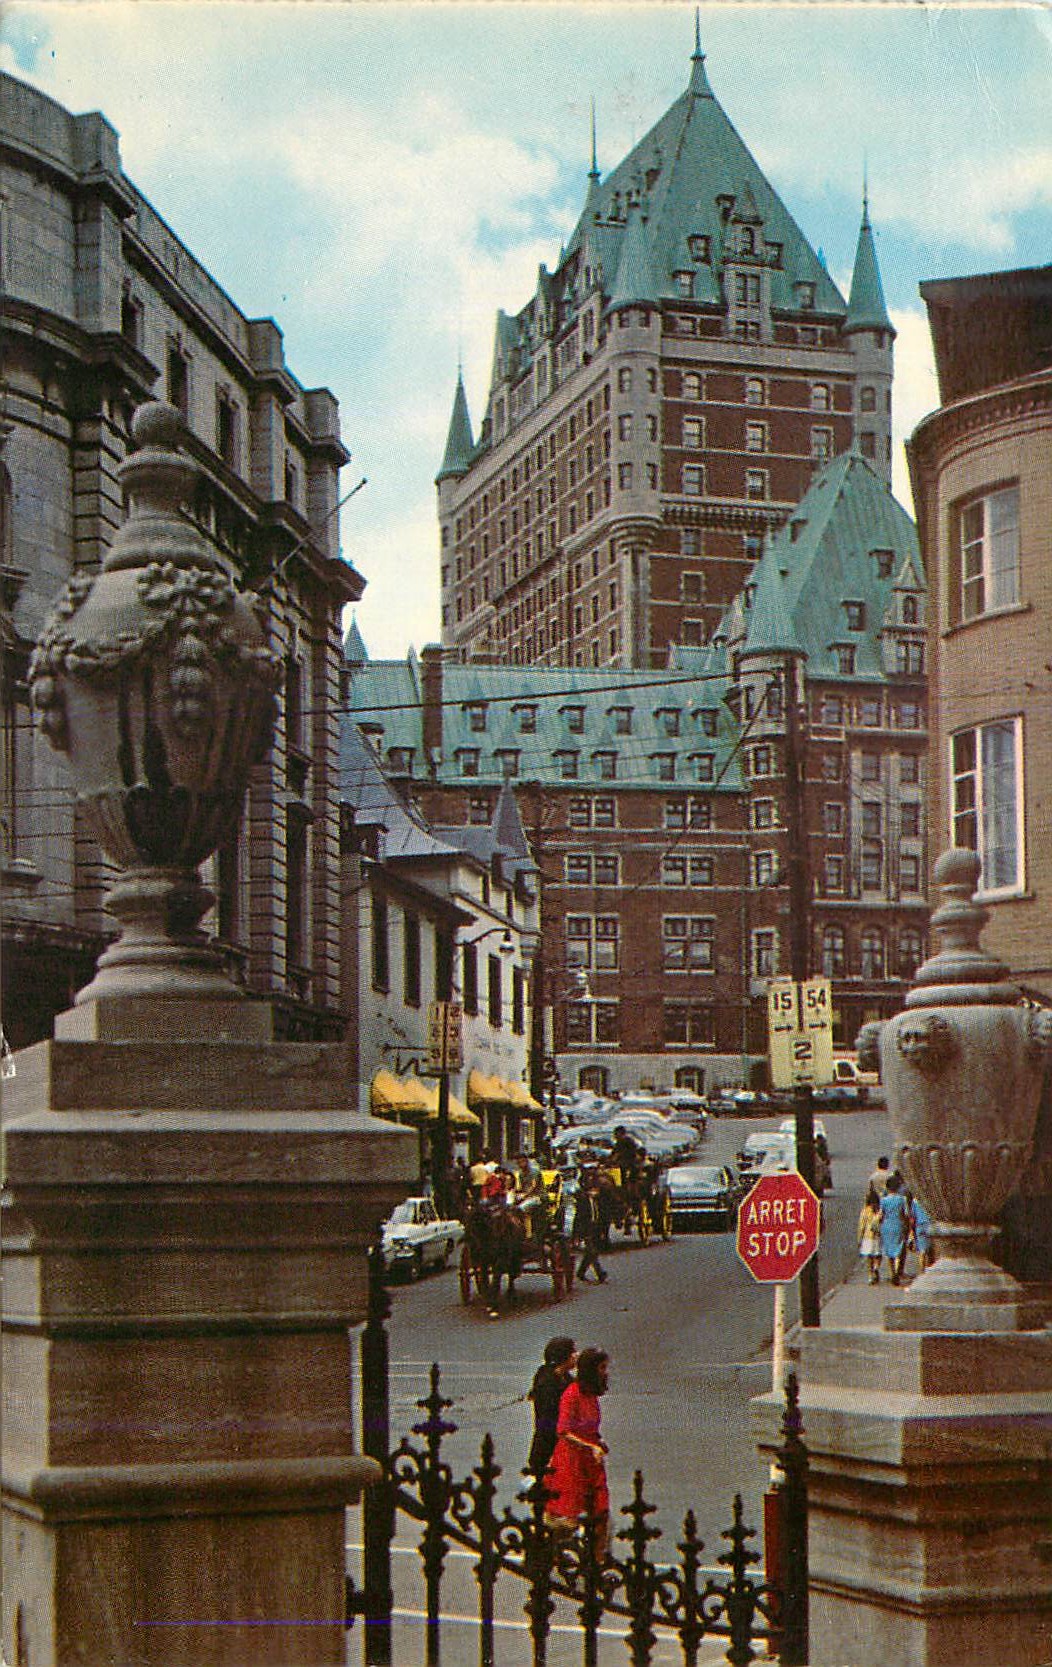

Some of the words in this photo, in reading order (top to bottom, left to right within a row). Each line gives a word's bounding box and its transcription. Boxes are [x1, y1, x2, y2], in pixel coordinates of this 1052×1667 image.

[773, 991, 793, 1010] 15
[807, 988, 827, 1008] 54
[793, 1040, 812, 1060] 2
[746, 1198, 807, 1225] ARRET
[746, 1231, 807, 1257] STOP
